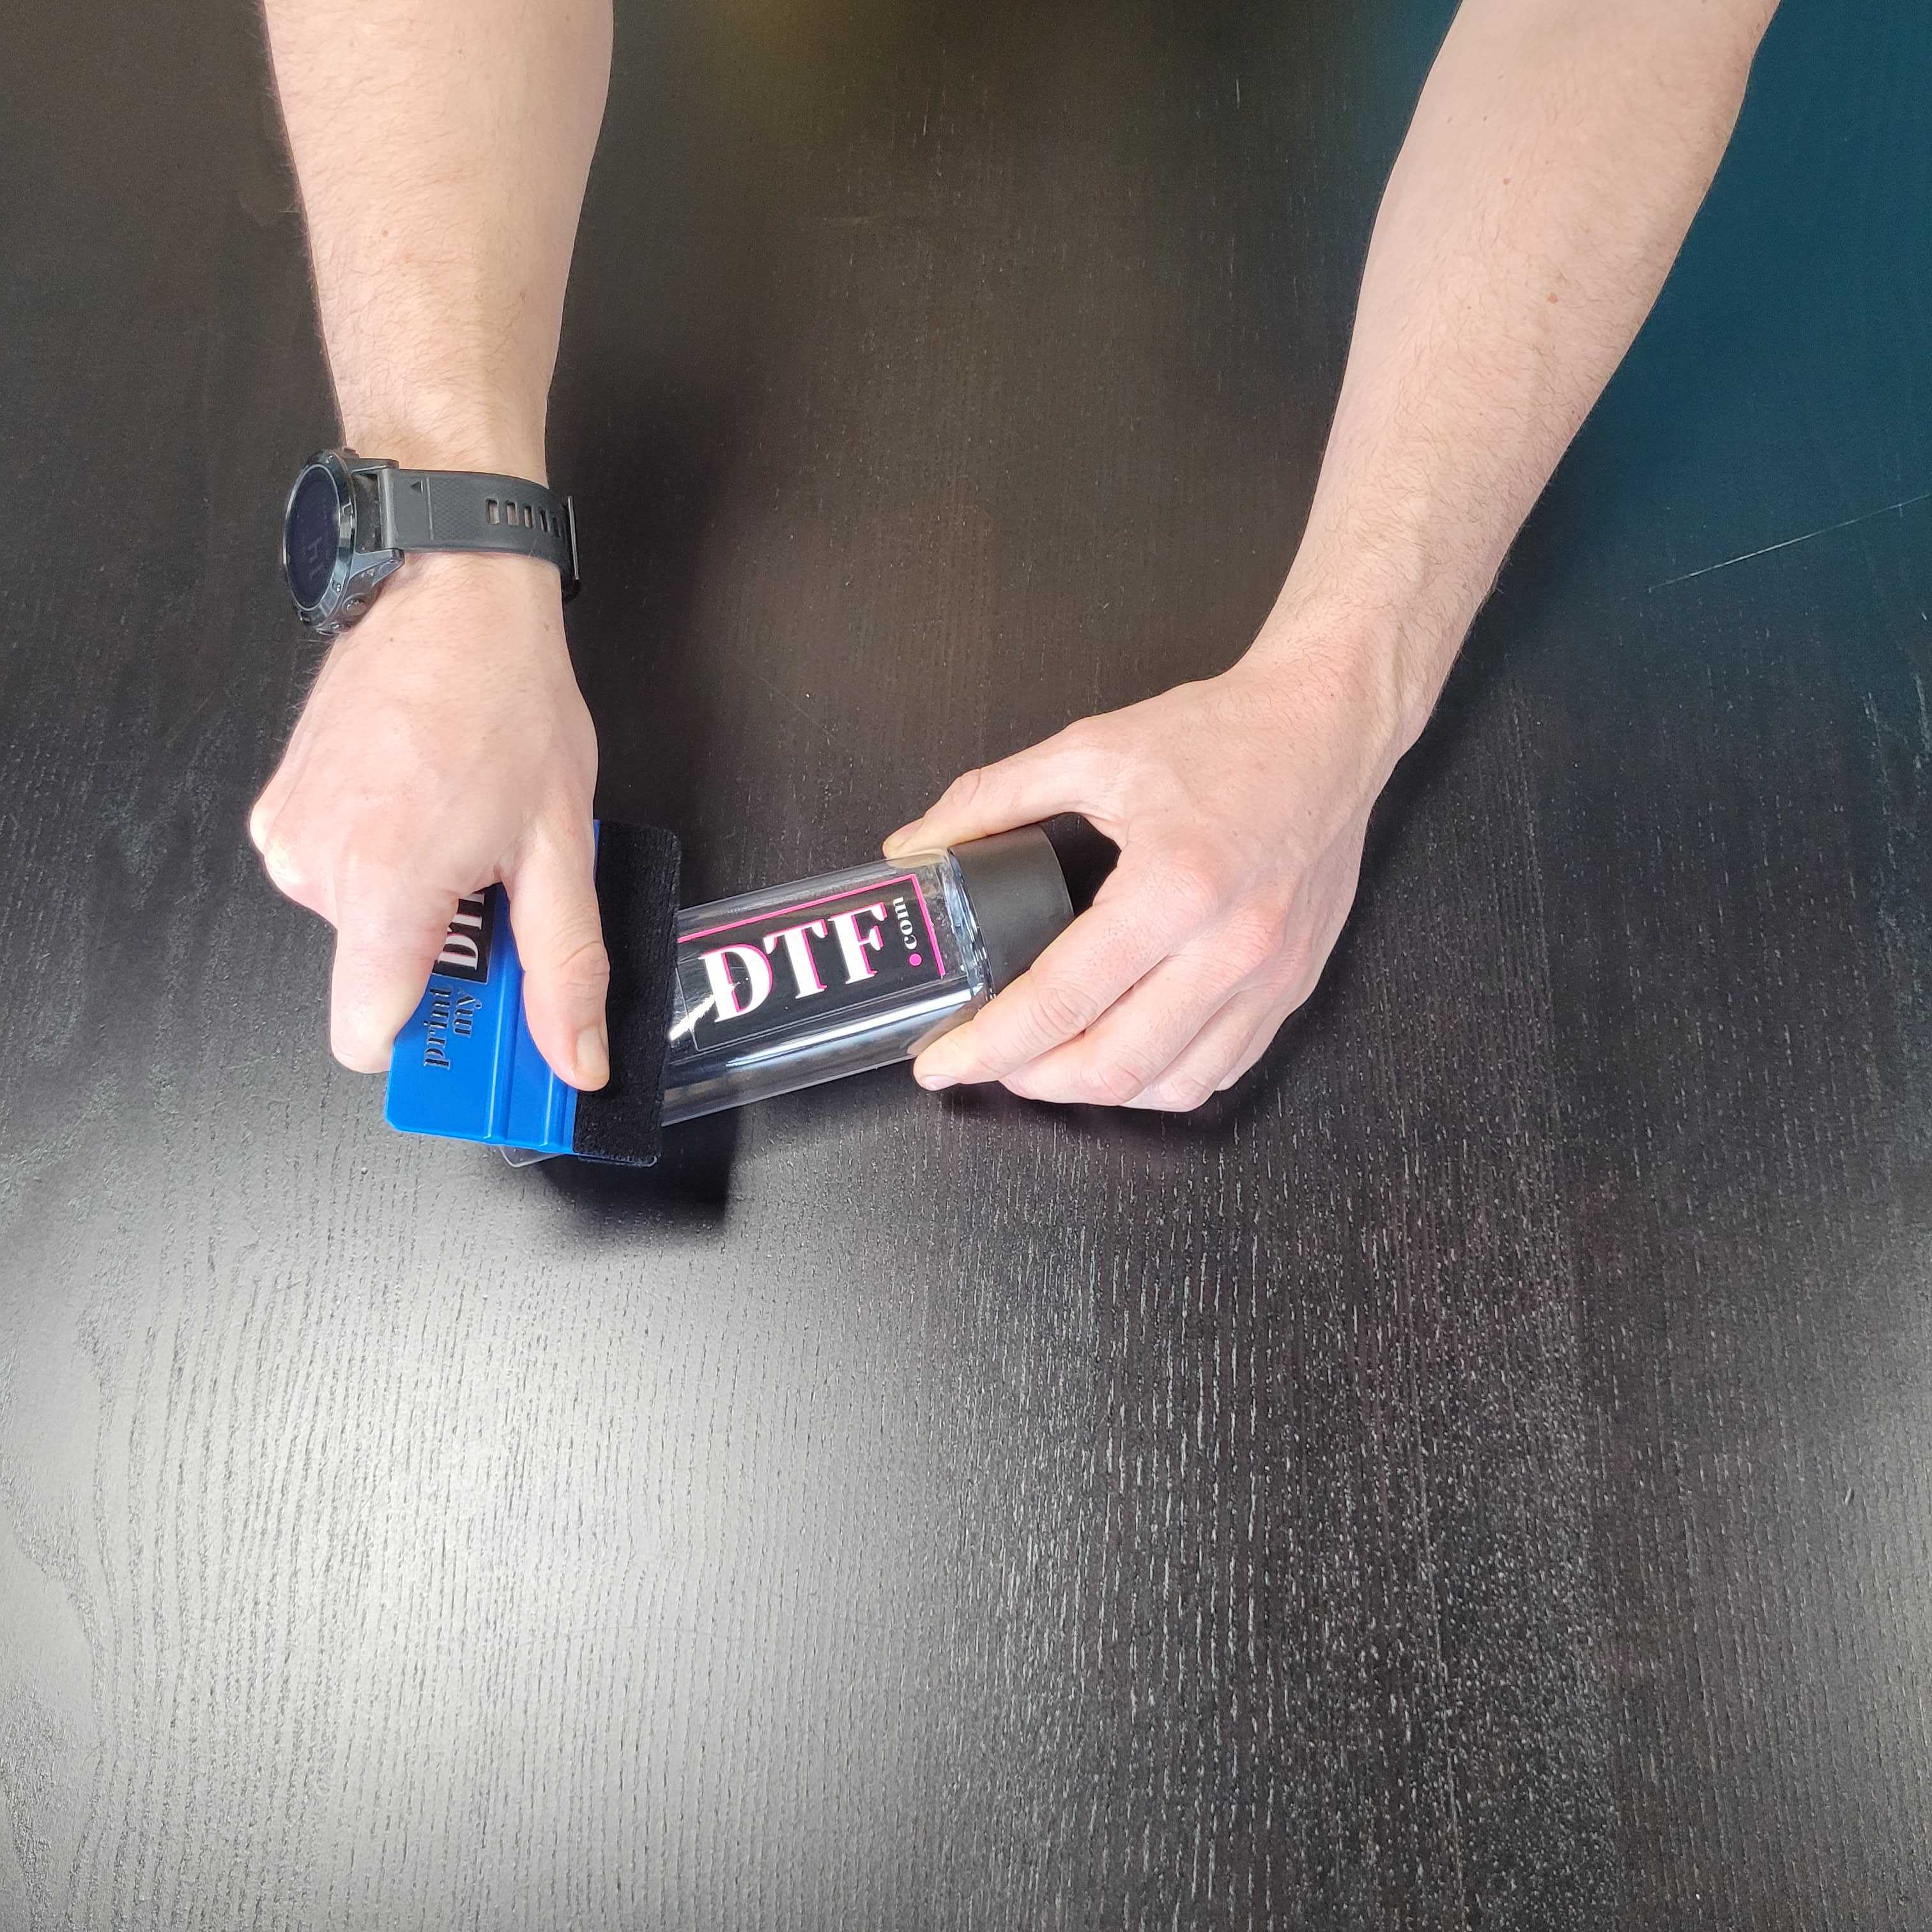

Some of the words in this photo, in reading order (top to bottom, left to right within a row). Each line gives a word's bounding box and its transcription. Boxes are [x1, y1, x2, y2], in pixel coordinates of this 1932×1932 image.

[438, 893, 484, 970] DT
[698, 901, 888, 1023] DTF
[423, 987, 451, 1070] print
[453, 988, 482, 1038] my
